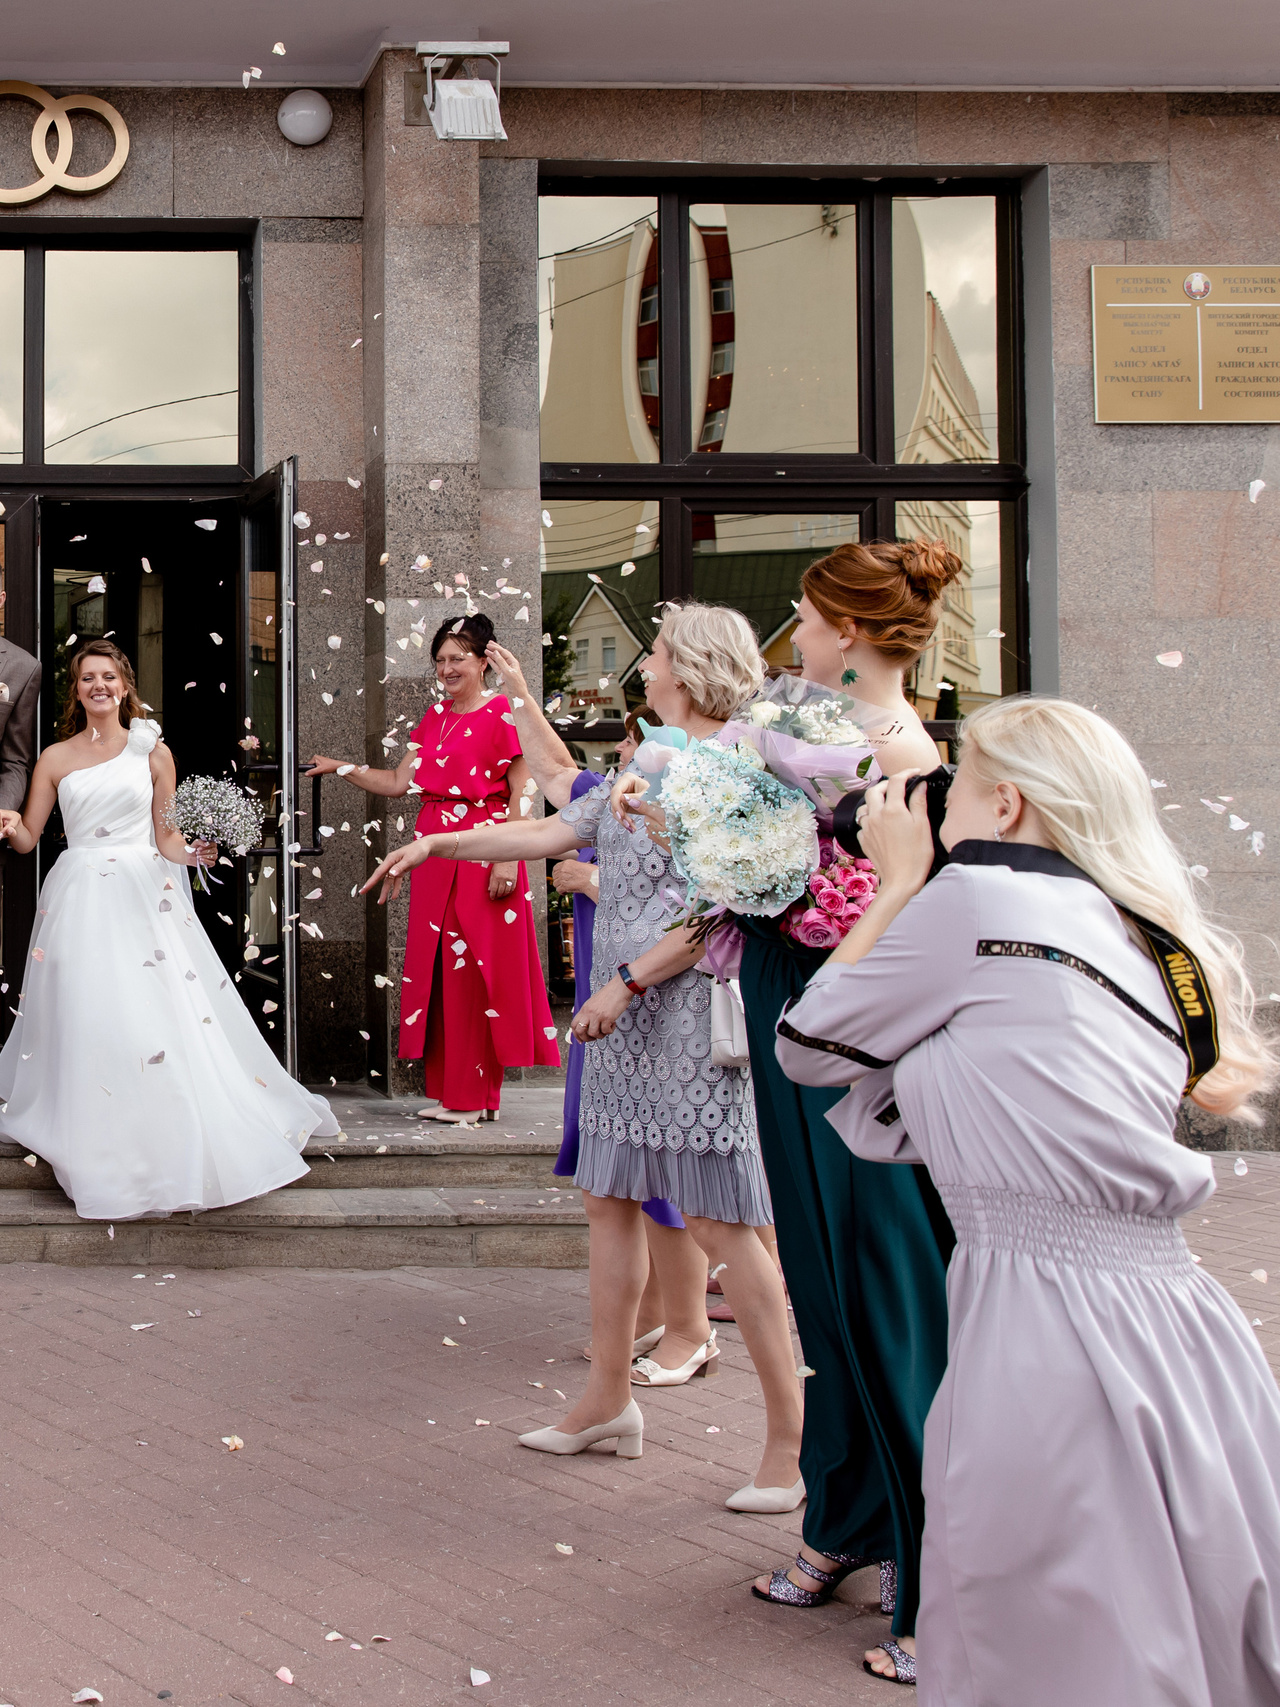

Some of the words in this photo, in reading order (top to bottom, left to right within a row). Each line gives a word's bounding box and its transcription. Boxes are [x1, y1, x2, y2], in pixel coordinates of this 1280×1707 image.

[1121, 286, 1167, 294] БЕЛАРУСЬ
[1230, 286, 1276, 294] БЕЛАРУСЬ
[1128, 345, 1166, 354] АДДЗЕЛ
[1236, 345, 1268, 354] ОТДЕЛ
[1113, 360, 1147, 369] ЗАПІСУ
[1151, 358, 1181, 369] АКТАЎ
[1217, 360, 1255, 369] ЗАПИСИ
[1214, 375, 1280, 384] ГРАЖДАНСКО
[1131, 390, 1164, 398] СТАНУ
[1164, 951, 1205, 1017] Nikon
